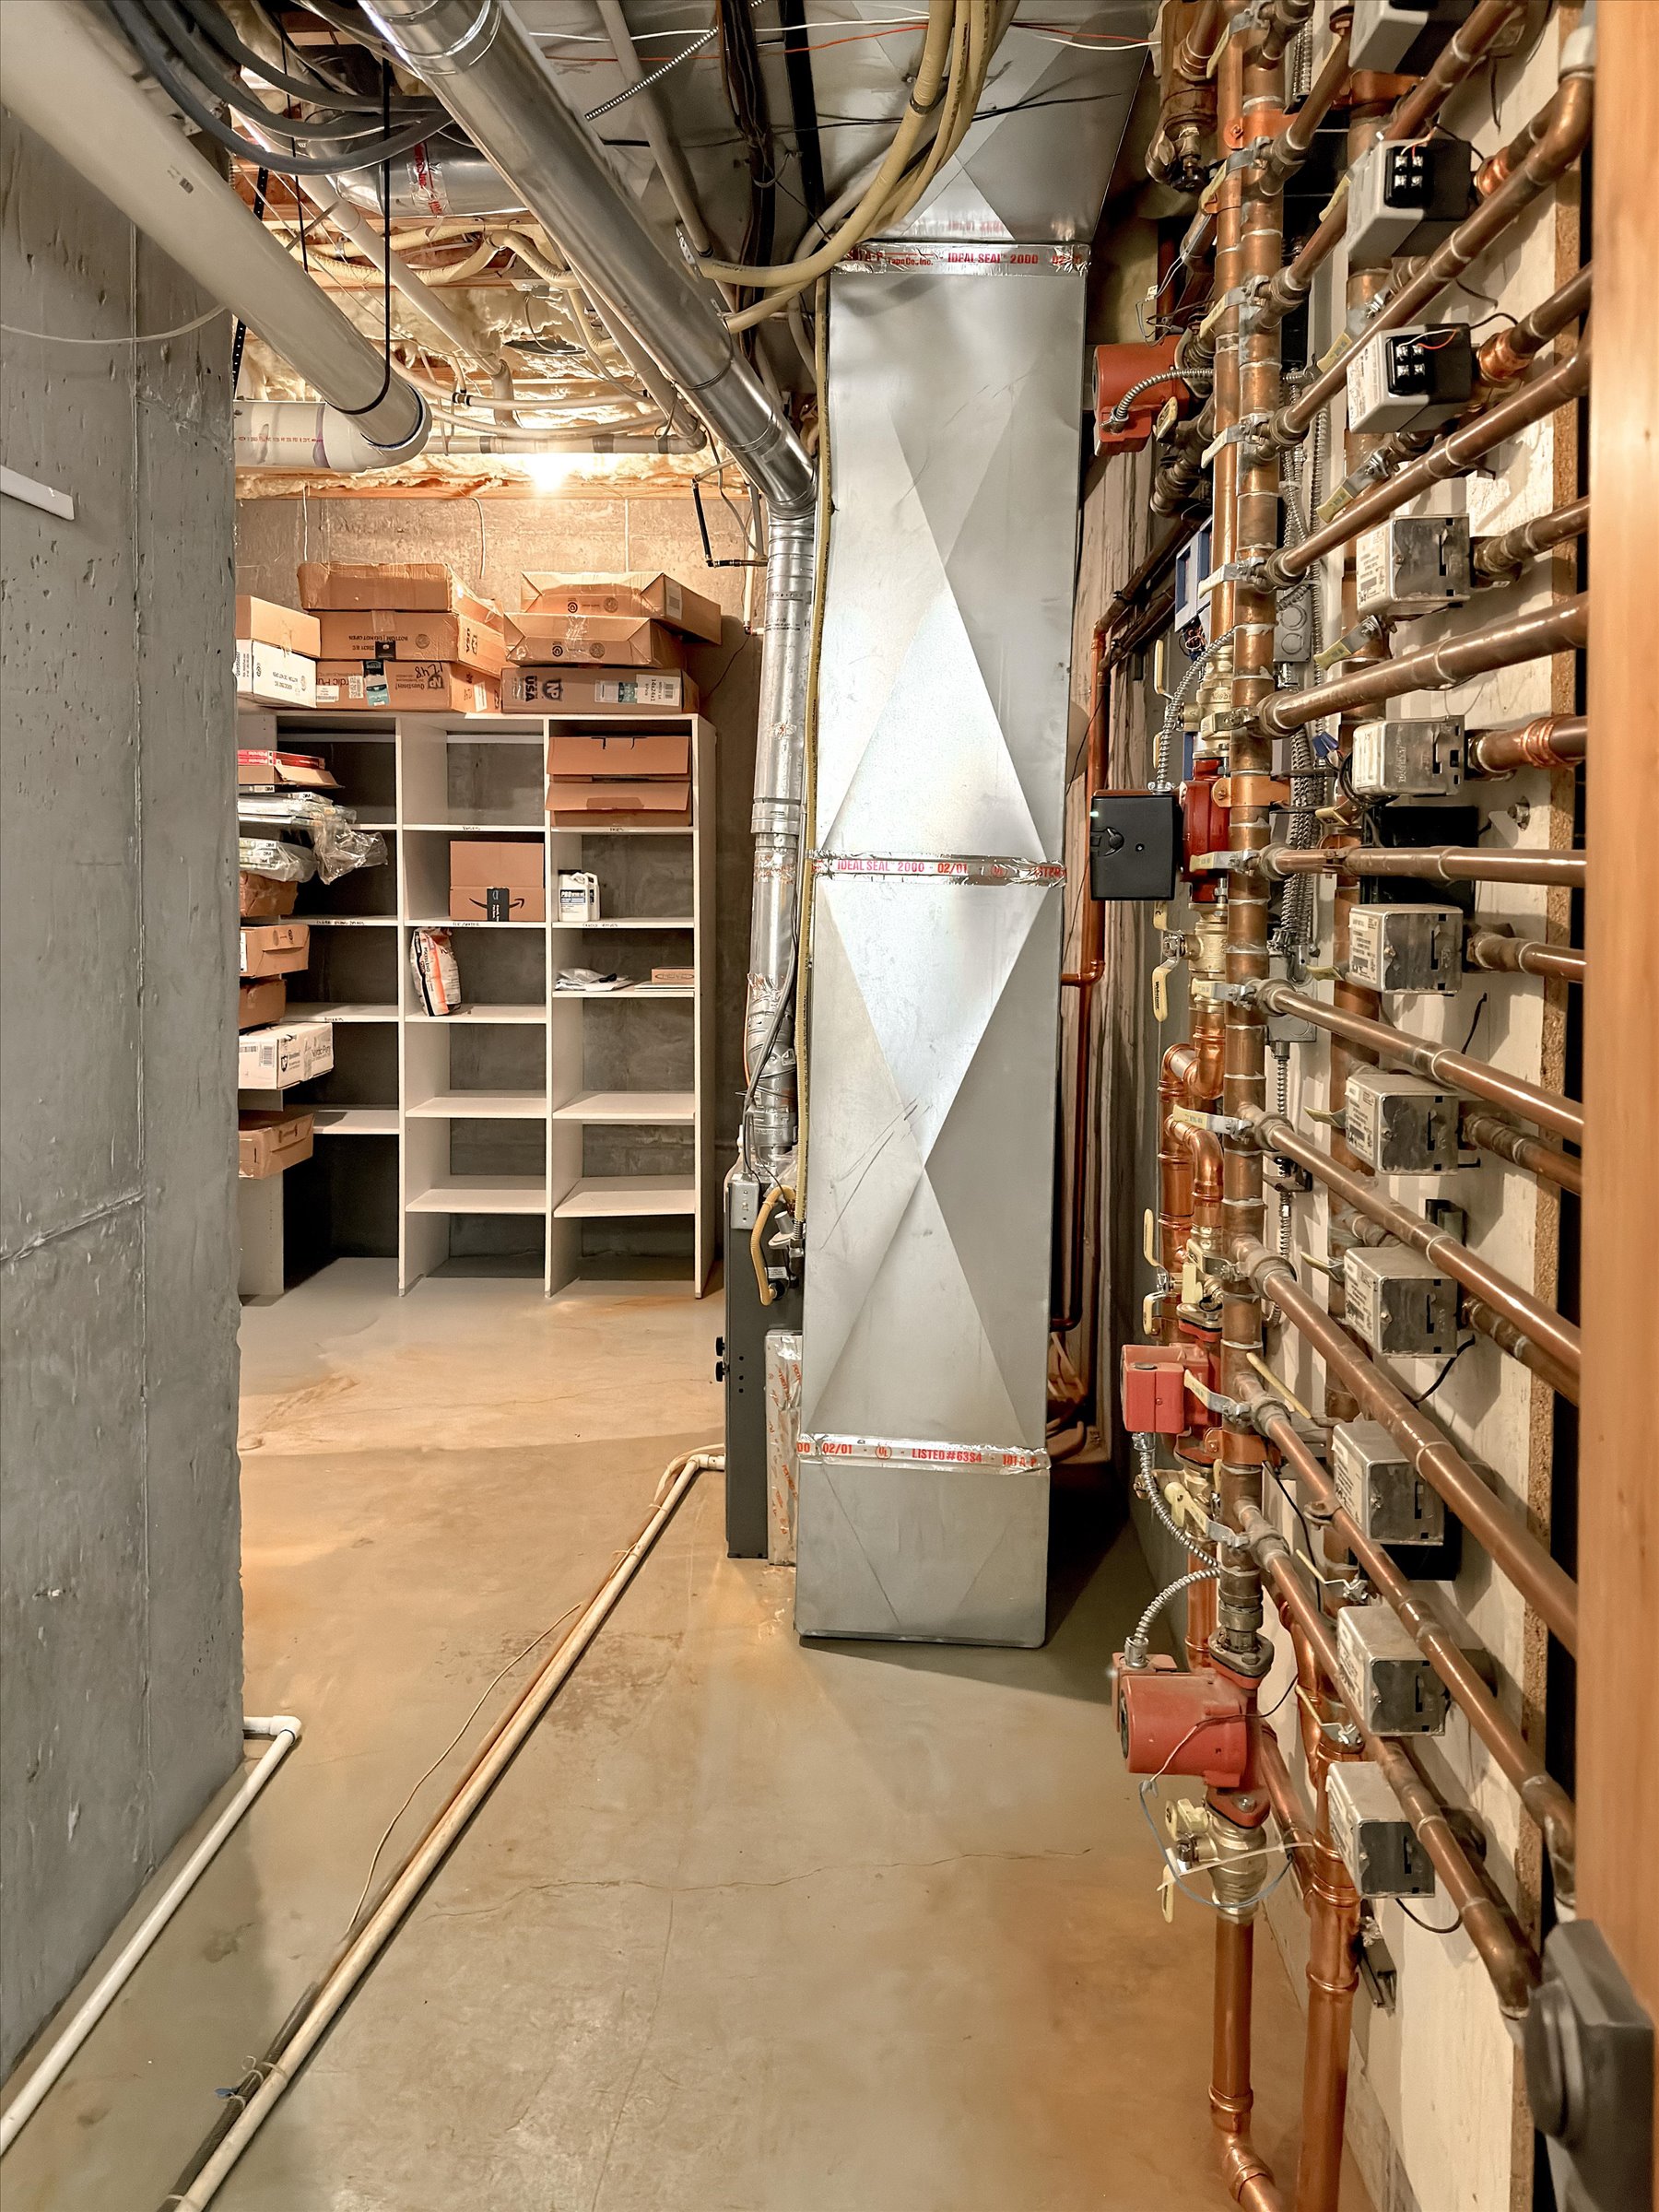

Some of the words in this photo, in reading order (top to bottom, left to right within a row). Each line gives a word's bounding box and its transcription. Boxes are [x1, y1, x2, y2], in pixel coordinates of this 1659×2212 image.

[947, 253, 974, 264] IDEAL
[1009, 254, 1039, 265] 2000
[332, 677, 349, 687] rdic
[524, 675, 535, 702] USA
[837, 859, 865, 871] IDEAL
[898, 862, 925, 873] 2000
[936, 863, 969, 875] 02/01
[796, 1442, 810, 1453] 00
[822, 1441, 853, 1454] 02/01
